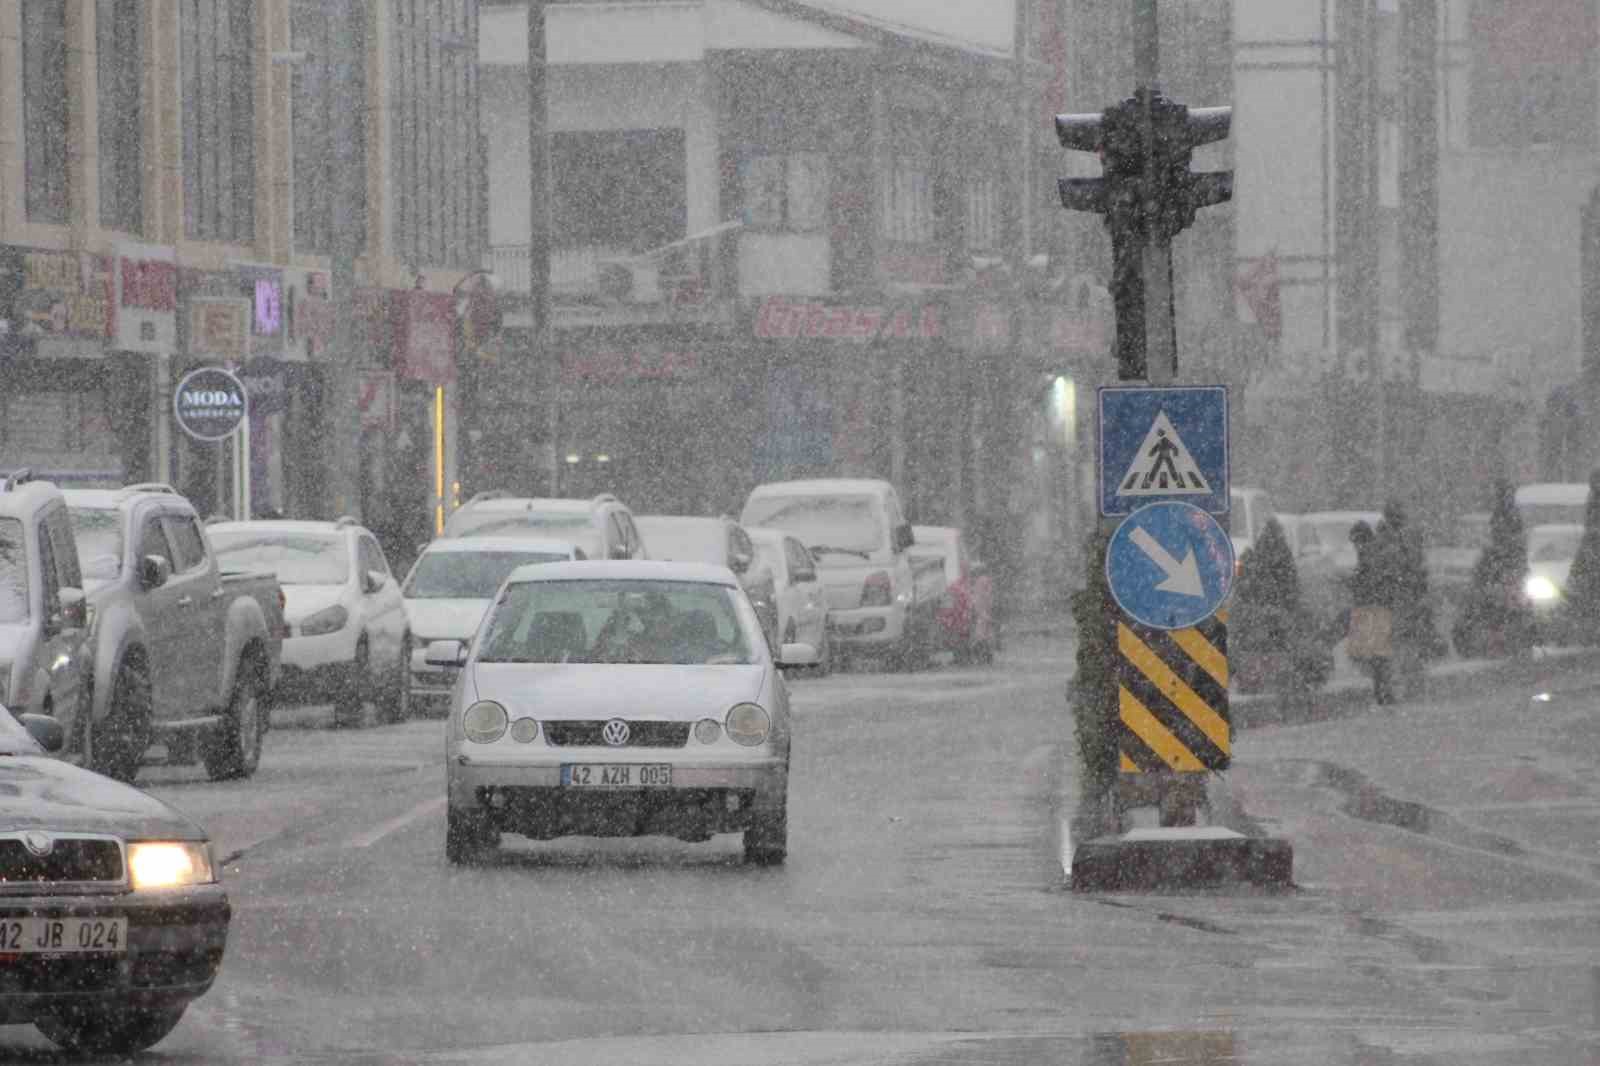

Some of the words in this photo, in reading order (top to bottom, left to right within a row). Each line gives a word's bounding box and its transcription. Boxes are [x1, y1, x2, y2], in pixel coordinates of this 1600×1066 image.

[182, 391, 241, 405] MODA
[572, 766, 591, 784] 42
[601, 766, 630, 784] AZH
[640, 766, 669, 784] 005
[78, 921, 119, 948] 024
